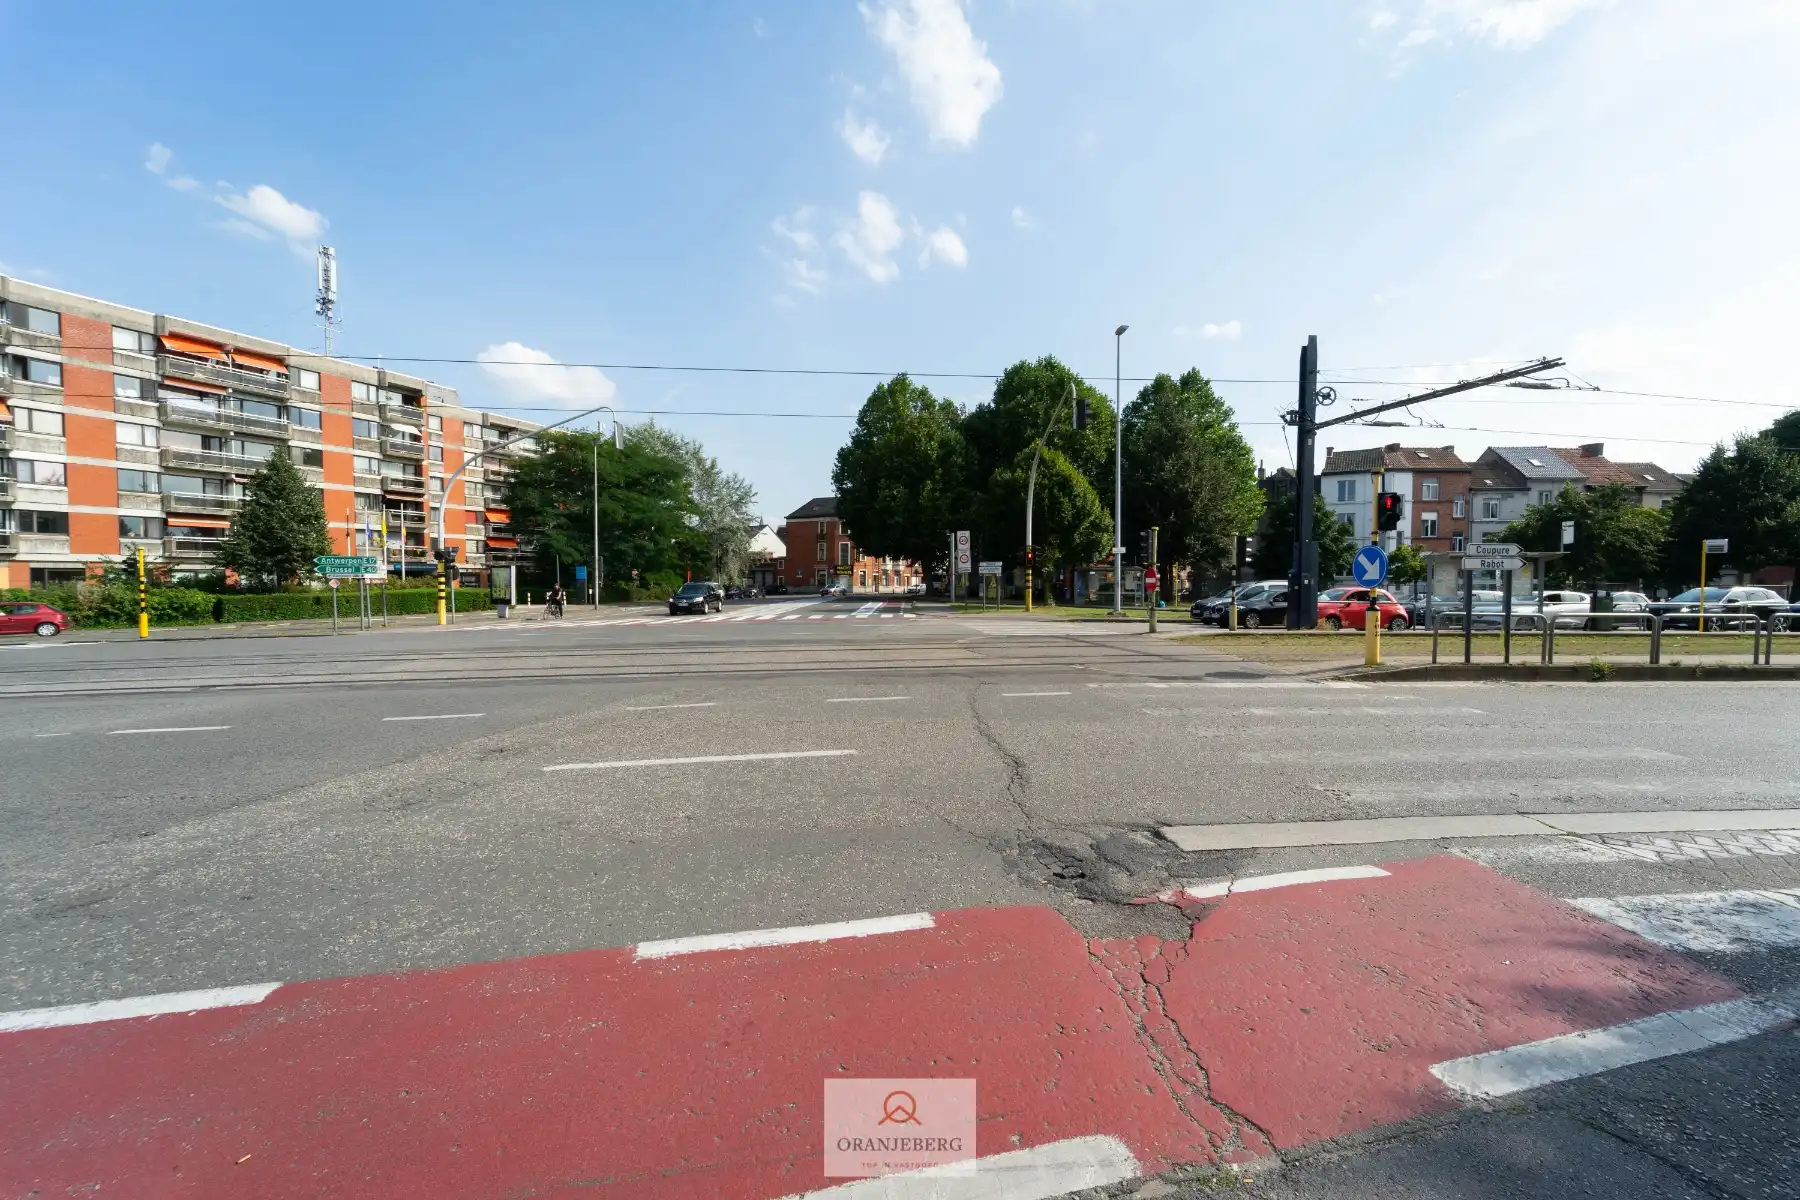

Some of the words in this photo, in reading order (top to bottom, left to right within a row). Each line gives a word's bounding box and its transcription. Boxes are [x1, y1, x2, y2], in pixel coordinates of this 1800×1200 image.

[1476, 545, 1510, 555] Coupure
[321, 557, 361, 566] Antwerpen
[1480, 559, 1505, 569] Rabot
